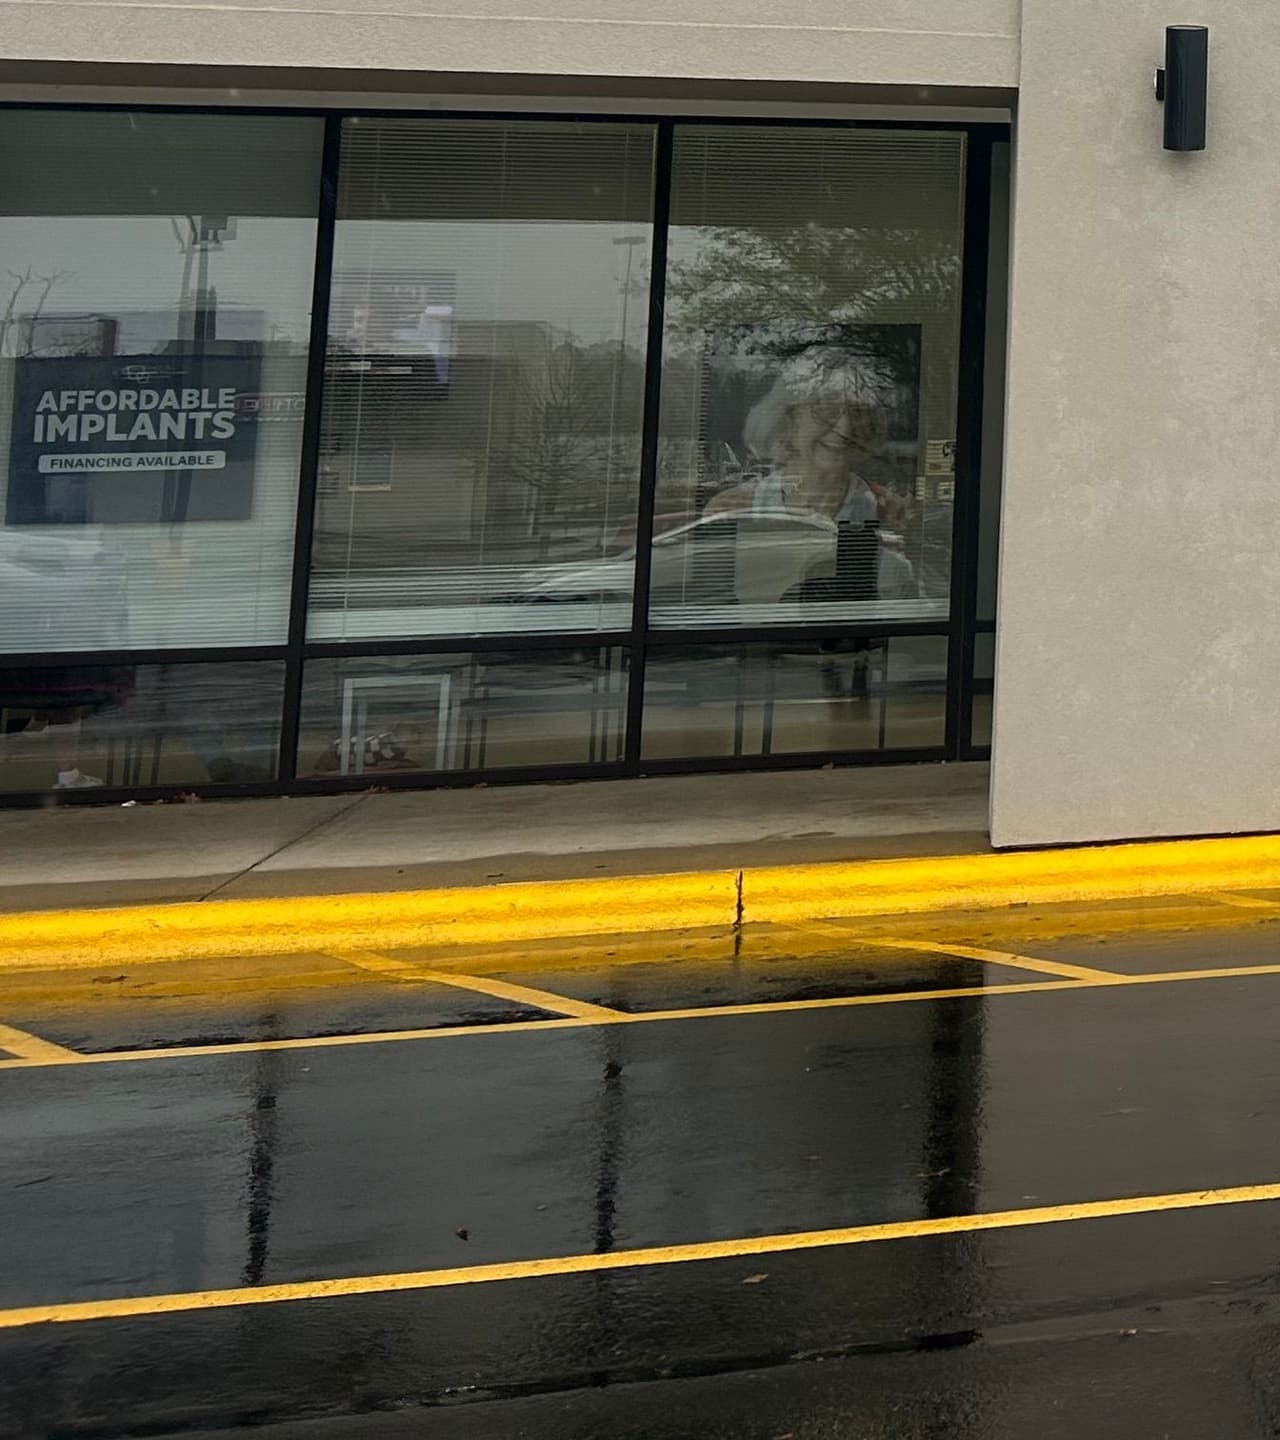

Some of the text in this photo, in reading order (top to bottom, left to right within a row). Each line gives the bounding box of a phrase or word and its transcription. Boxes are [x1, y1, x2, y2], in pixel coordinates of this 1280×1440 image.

[36, 388, 237, 411] AFFORDABLE
[33, 412, 236, 443] IMPLANTS
[50, 455, 214, 469] FINANCING AVAILABLE
